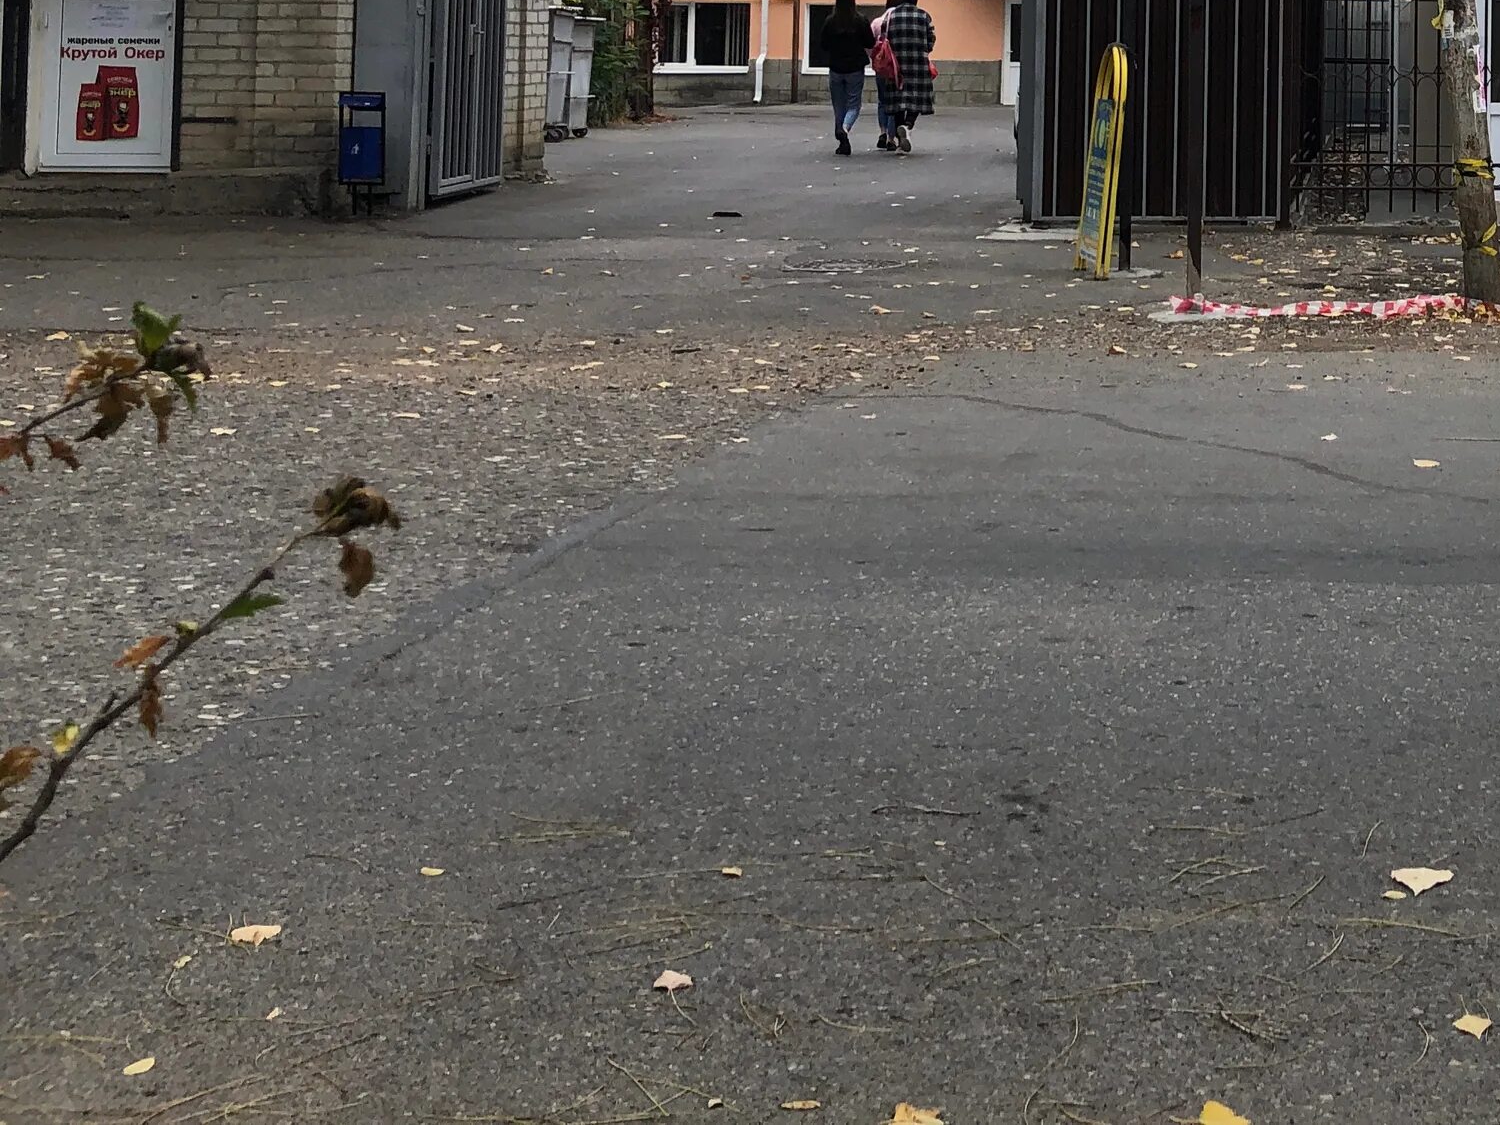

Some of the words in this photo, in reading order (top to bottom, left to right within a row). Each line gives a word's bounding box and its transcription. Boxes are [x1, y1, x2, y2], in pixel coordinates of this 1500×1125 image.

[67, 37, 114, 45] жареные
[117, 37, 160, 45] семечки
[60, 46, 118, 60] Крутой
[124, 46, 165, 60] Окер
